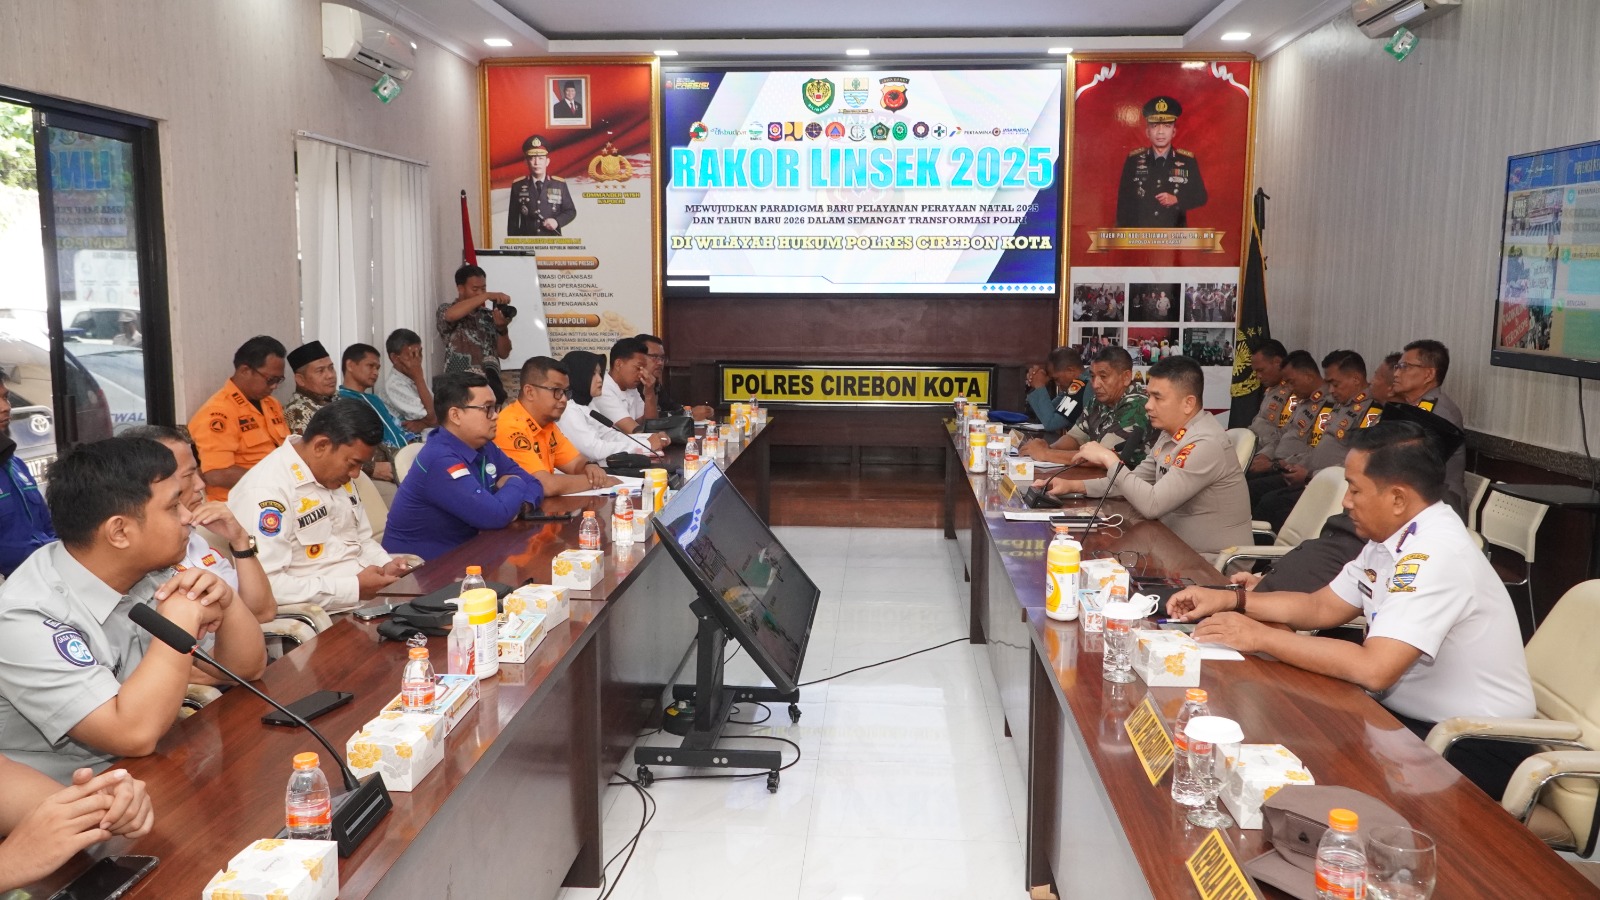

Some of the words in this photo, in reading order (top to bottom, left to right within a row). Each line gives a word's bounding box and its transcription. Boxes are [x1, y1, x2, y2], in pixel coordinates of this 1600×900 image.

[672, 147, 800, 189] RAKOR
[808, 147, 941, 189] LINSEK
[950, 146, 1054, 188] 2025
[685, 204, 759, 214] MEWUJUDKAN
[759, 204, 825, 213] PARADIGMA
[826, 204, 855, 213] BARU
[856, 204, 919, 213] PELAYANAN
[920, 204, 978, 213] PERAYAAN
[979, 204, 1015, 213] NATAL
[1016, 204, 1039, 213] 2025
[692, 216, 715, 225] DAN
[717, 216, 752, 225] TAHUN
[753, 216, 782, 225] BARU
[783, 216, 805, 225] 2026
[807, 216, 846, 225] DALAM
[847, 216, 906, 225] SEMANGAT
[909, 216, 991, 225] TRANSFORMASI
[993, 216, 1027, 225] POLRI
[671, 235, 693, 250] DI
[694, 235, 776, 250] WILAYAH
[777, 235, 844, 250] HUKUM
[845, 235, 914, 250] POLRES
[915, 235, 999, 250] CIREBON
[1000, 235, 1053, 250] KOTA
[558, 317, 587, 325] KAPOLRI
[731, 373, 814, 395] POLRES
[820, 375, 917, 397] CIREBON
[923, 377, 982, 398] KOTA
[1190, 834, 1233, 898] KEPALA
